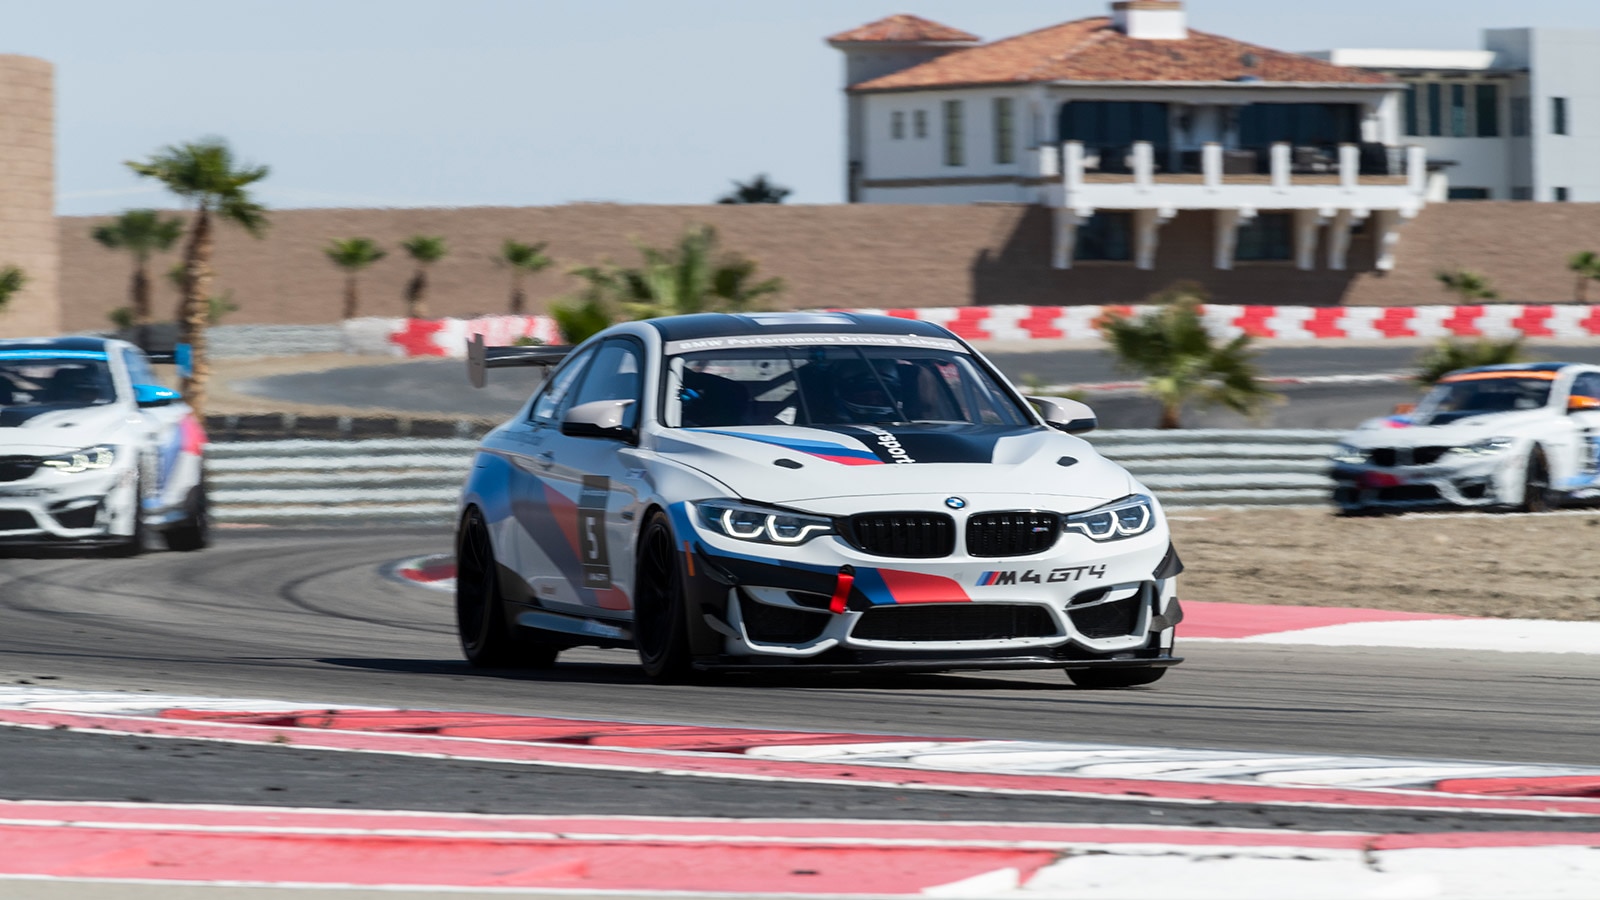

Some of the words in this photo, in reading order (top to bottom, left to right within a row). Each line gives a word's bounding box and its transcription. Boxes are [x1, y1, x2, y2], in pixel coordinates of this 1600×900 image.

[679, 340, 723, 350] BMW
[727, 336, 835, 346] Performance
[839, 335, 898, 345] Driving
[900, 337, 956, 349] School
[585, 516, 599, 560] 5
[1046, 564, 1107, 583] GT4
